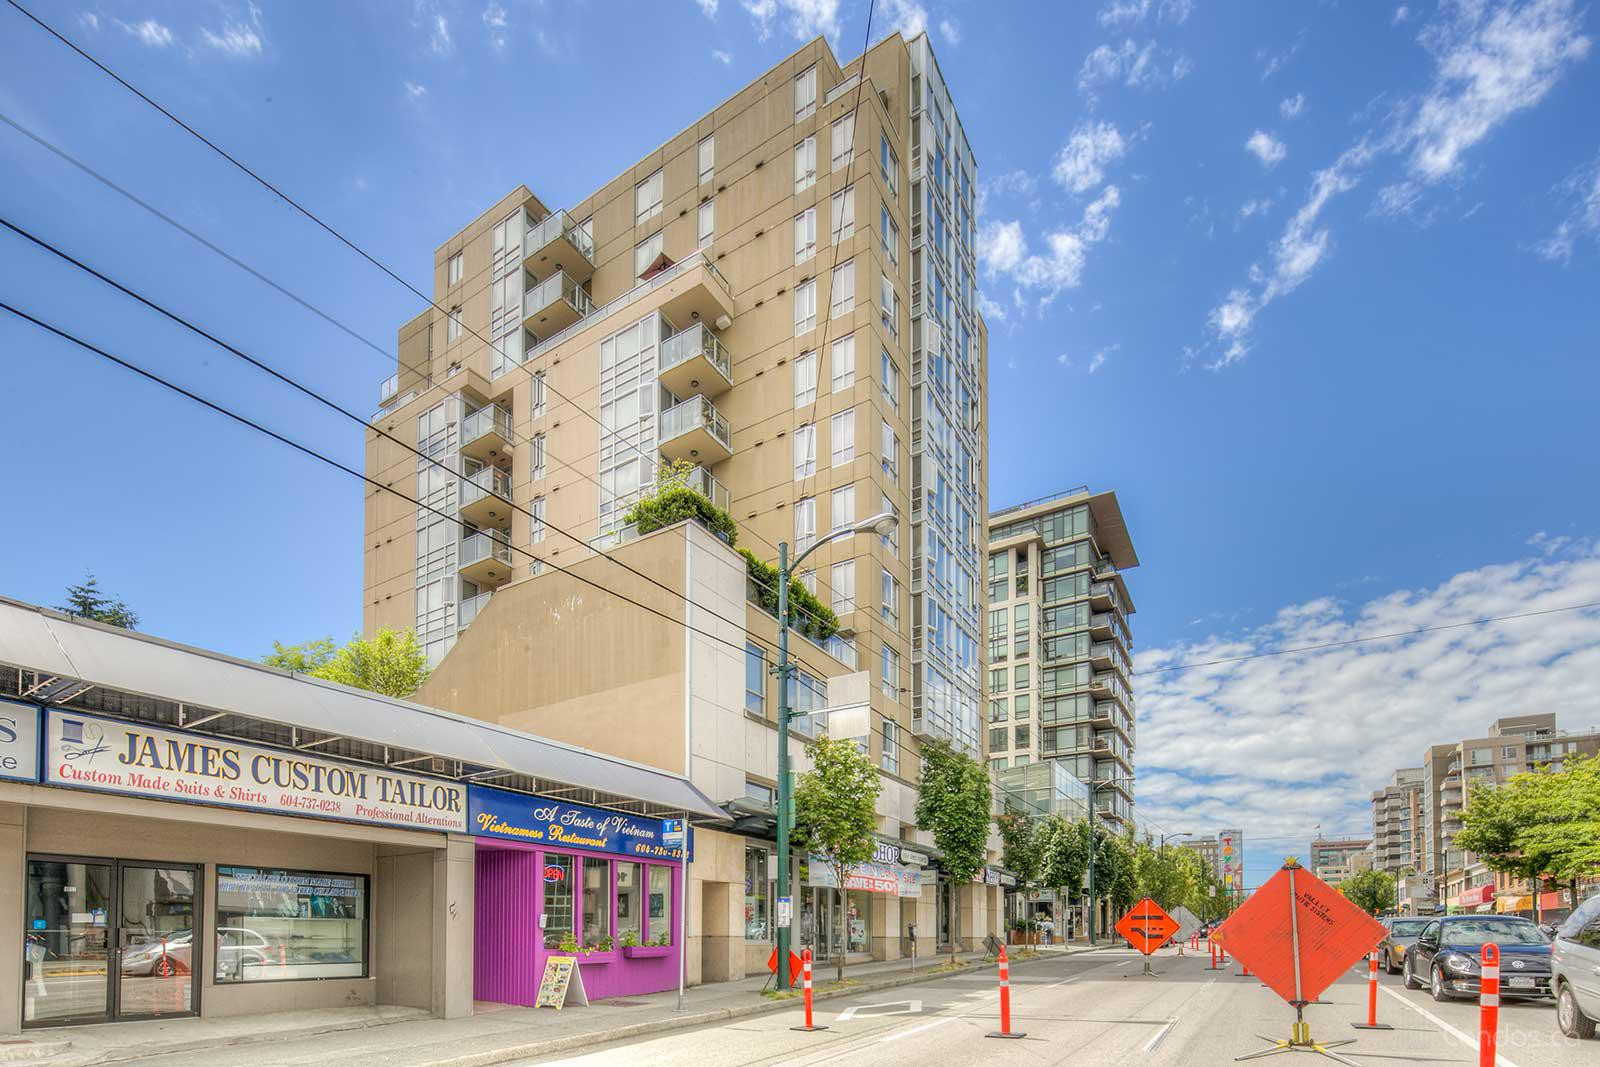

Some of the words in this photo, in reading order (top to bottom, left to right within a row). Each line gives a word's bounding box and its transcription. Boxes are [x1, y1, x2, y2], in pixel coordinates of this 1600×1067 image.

[59, 763, 122, 785] Custom
[127, 772, 170, 791] Made
[174, 779, 210, 797] Suits
[214, 785, 225, 798] &
[229, 787, 267, 804] Shirts
[279, 794, 341, 812] 604-737-0238
[355, 804, 413, 823] Professional
[415, 812, 462, 829] Alterations
[118, 732, 241, 780] JAMES
[251, 754, 368, 801] CUSTOM
[376, 776, 462, 813] TAILOR
[477, 812, 544, 839] Vietnamese
[548, 823, 607, 848] Restaurant
[533, 805, 559, 822] A
[560, 810, 594, 829] Taste
[596, 816, 610, 836] of
[611, 817, 655, 839] Vietnam
